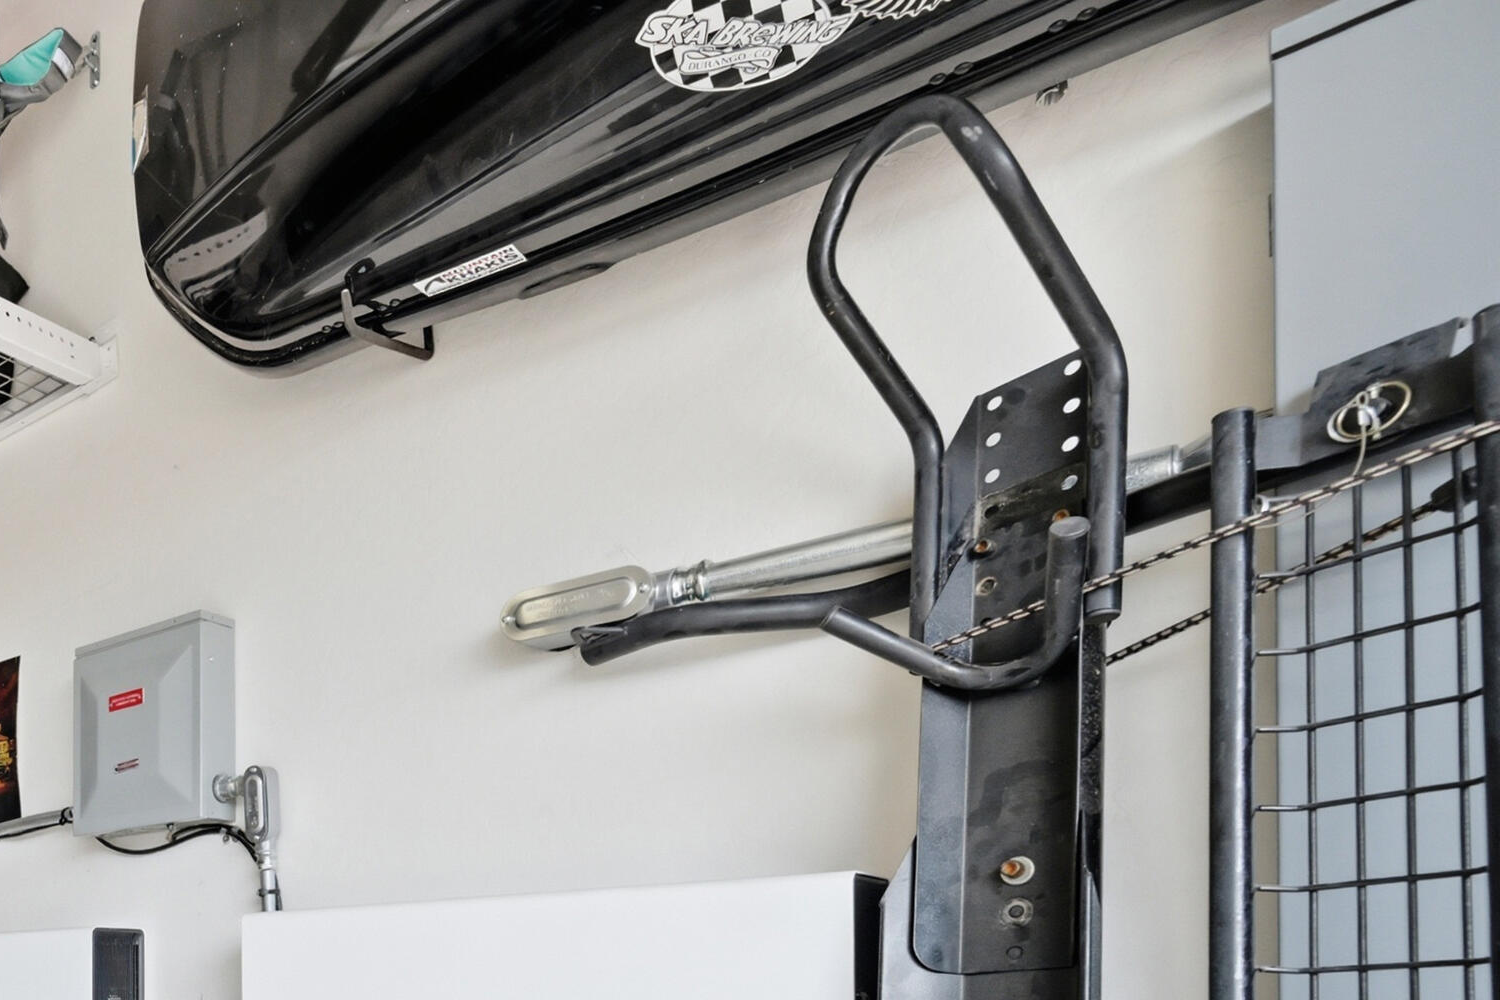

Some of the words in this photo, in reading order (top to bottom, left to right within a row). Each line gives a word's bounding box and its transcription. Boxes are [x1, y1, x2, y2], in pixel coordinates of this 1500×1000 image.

[641, 15, 708, 46] SKA
[711, 17, 850, 47] BREWING
[688, 53, 747, 71] DURANGO
[442, 247, 513, 278] MOUNTAIN
[446, 253, 518, 282] KHAKIS
